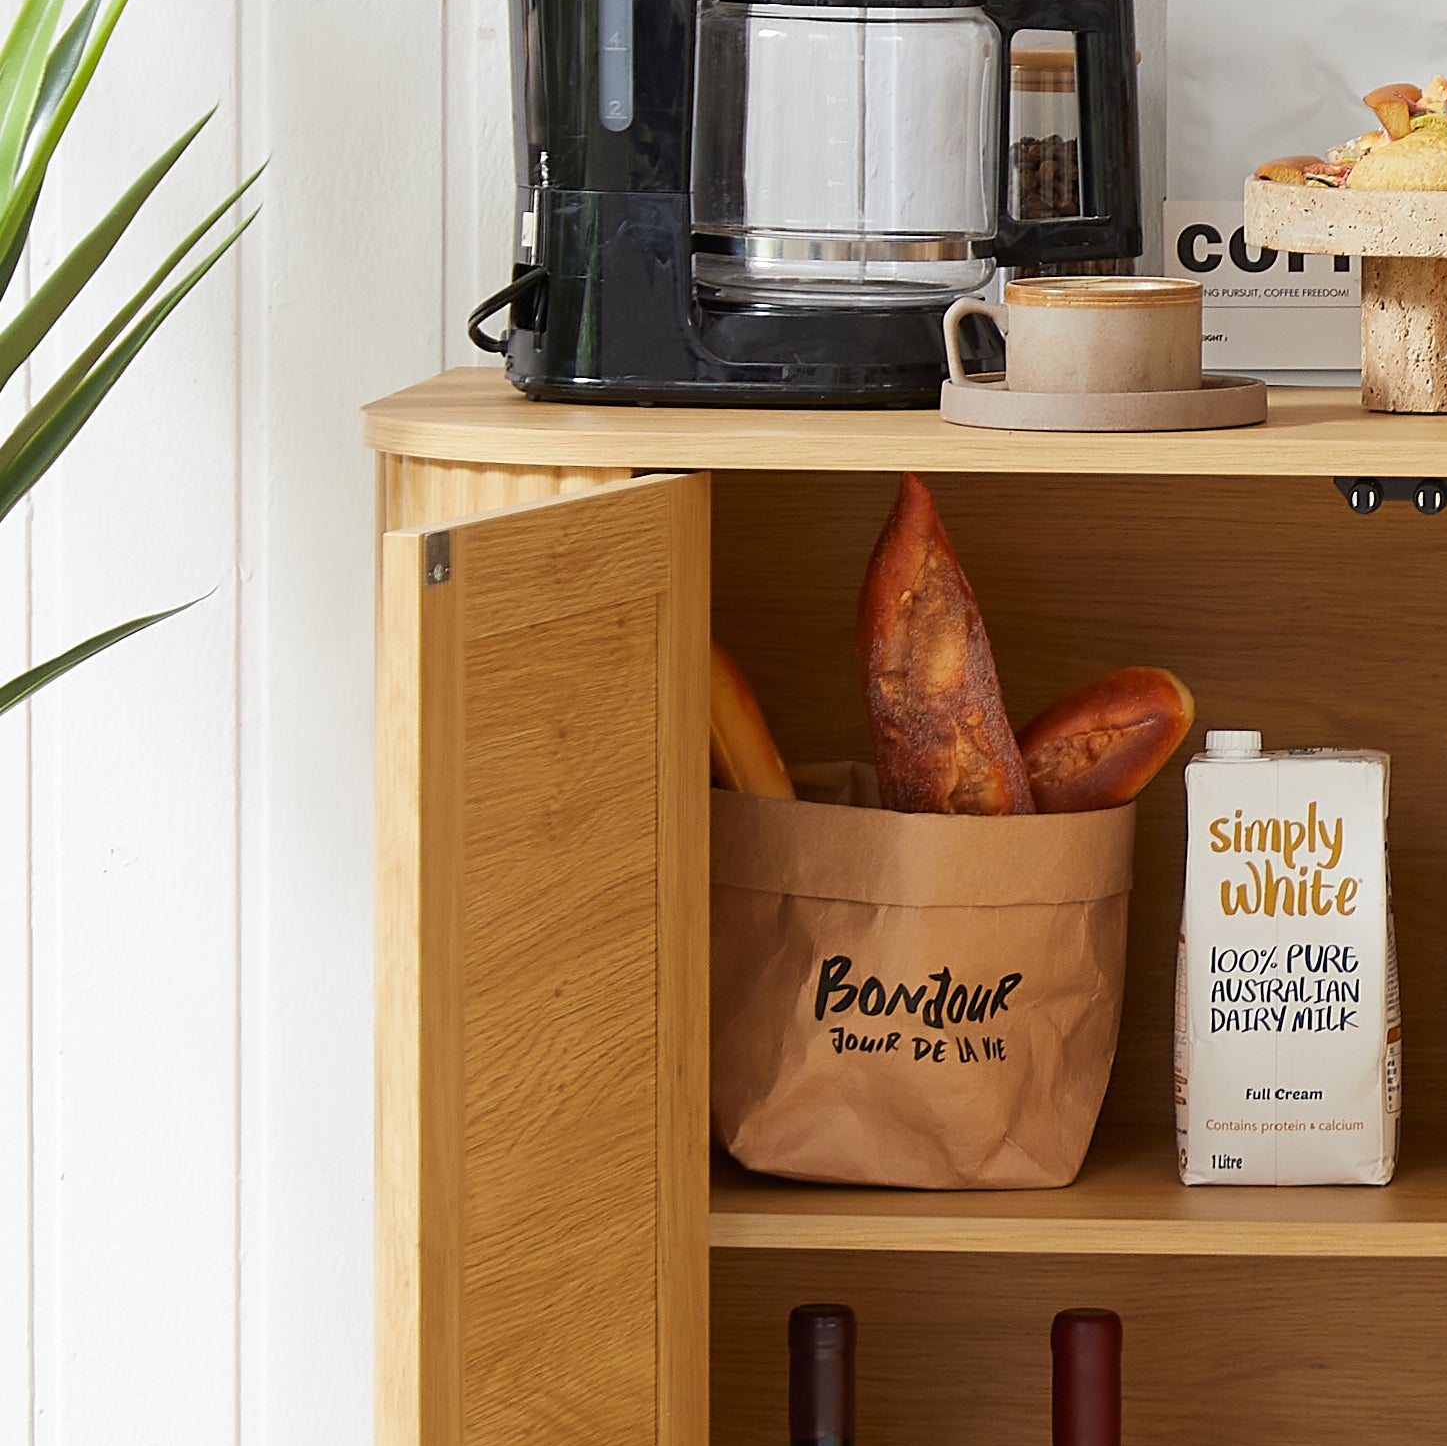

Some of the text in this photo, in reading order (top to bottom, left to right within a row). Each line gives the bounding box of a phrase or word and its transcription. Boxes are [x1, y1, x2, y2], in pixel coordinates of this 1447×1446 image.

[609, 32, 622, 47] 4
[609, 100, 622, 116] 2
[1221, 288, 1261, 299] PURSUIT,
[1263, 288, 1300, 298] COFFEE
[1302, 288, 1350, 298] FREEDOM!
[1209, 801, 1343, 870] simply
[1220, 859, 1359, 918] white
[1210, 944, 1359, 975] 100% PURE
[1211, 976, 1360, 1004] AUSTRALIAN
[1211, 1005, 1359, 1033] DAIRY MILK
[912, 1037, 948, 1063] DE
[956, 1036, 979, 1063] LA
[982, 1036, 1006, 1060] VIE
[1245, 1088, 1323, 1101] Full Cream
[1206, 1119, 1257, 1132] Contains
[1261, 1119, 1306, 1134] protein
[1318, 1119, 1364, 1131] calcium
[1211, 1154, 1243, 1170] 1 Litre
